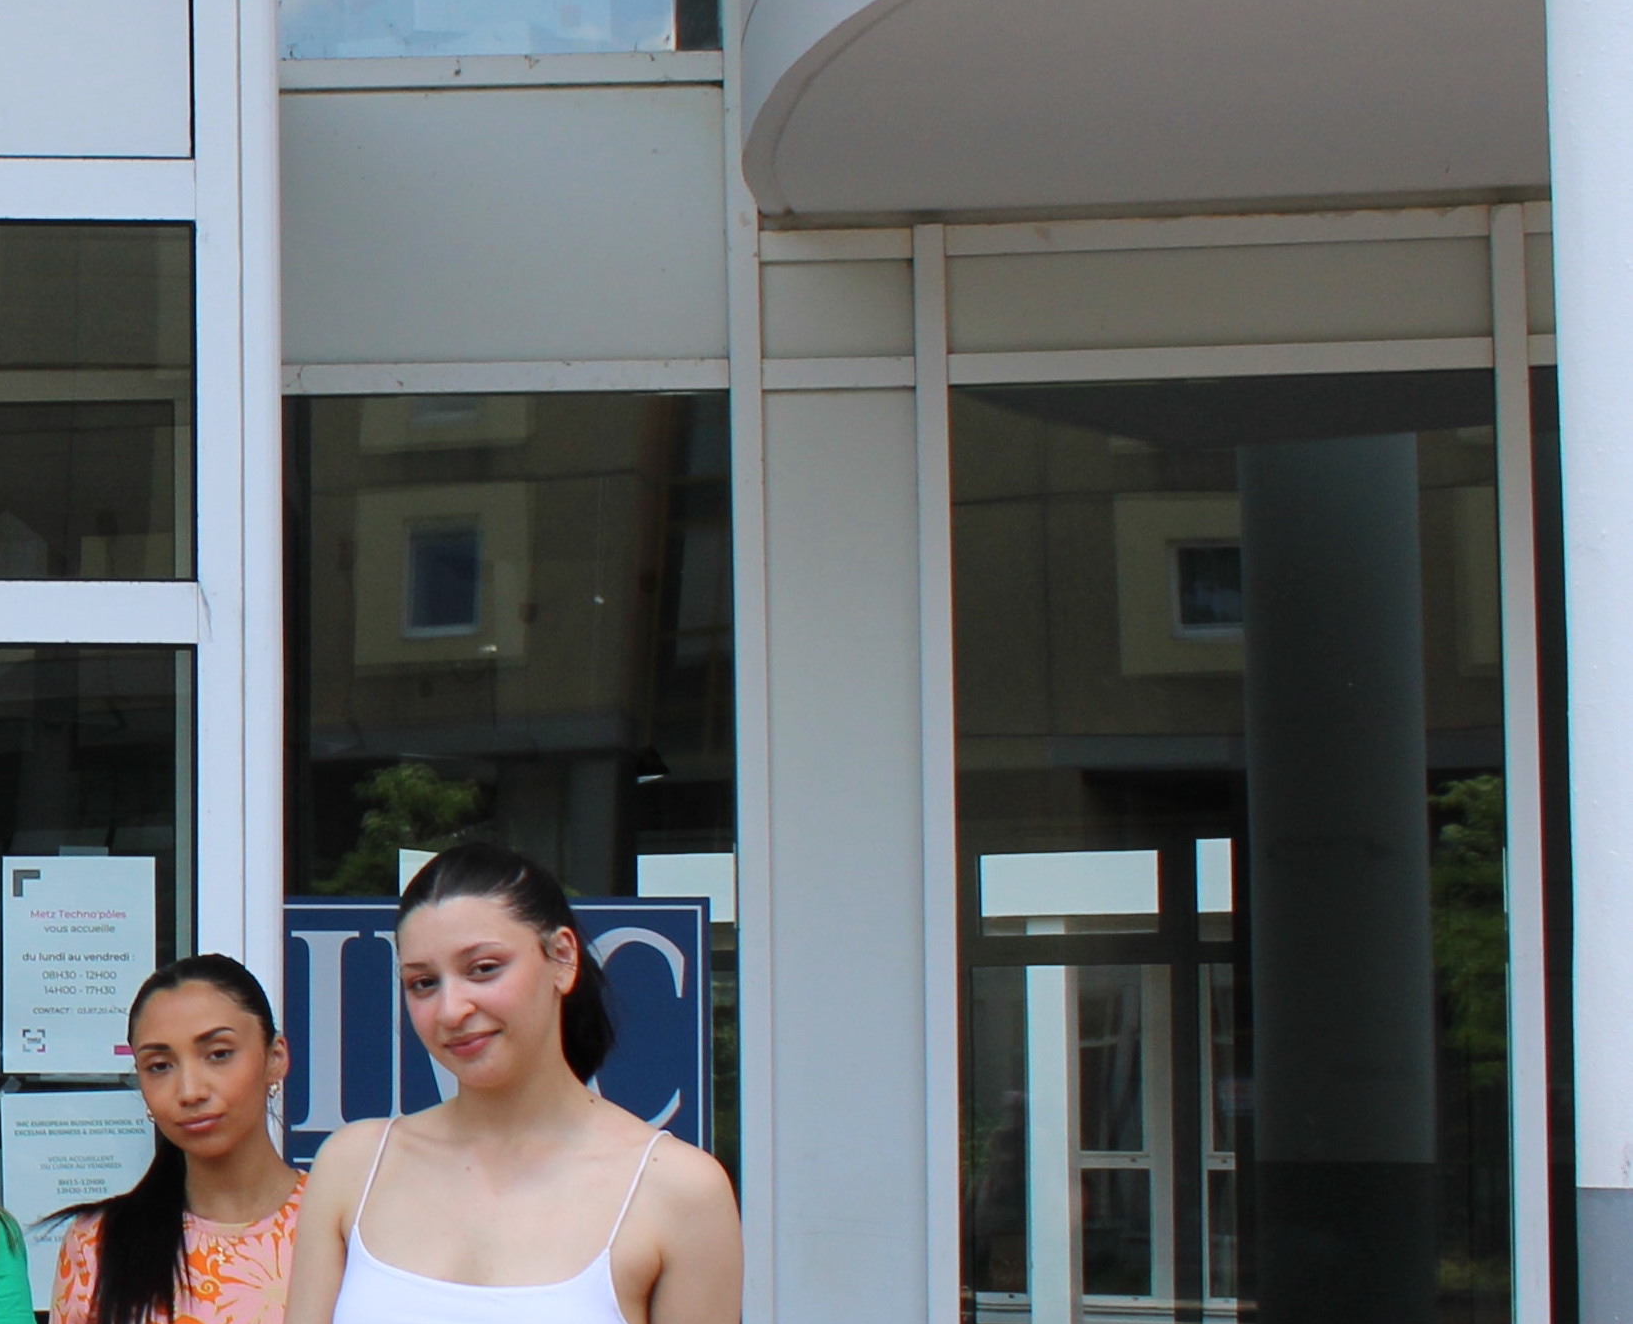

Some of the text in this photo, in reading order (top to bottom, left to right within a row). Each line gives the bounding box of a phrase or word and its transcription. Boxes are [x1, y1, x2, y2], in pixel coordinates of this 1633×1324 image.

[30, 910, 56, 919] Metz
[43, 924, 116, 933] vous accueille
[22, 952, 36, 961] du
[38, 952, 66, 961] lundi
[83, 952, 130, 961] vendredi
[41, 970, 77, 980] 08H30
[85, 970, 117, 980] 12H00
[43, 985, 77, 995] 14H00
[85, 985, 116, 995] 17H30
